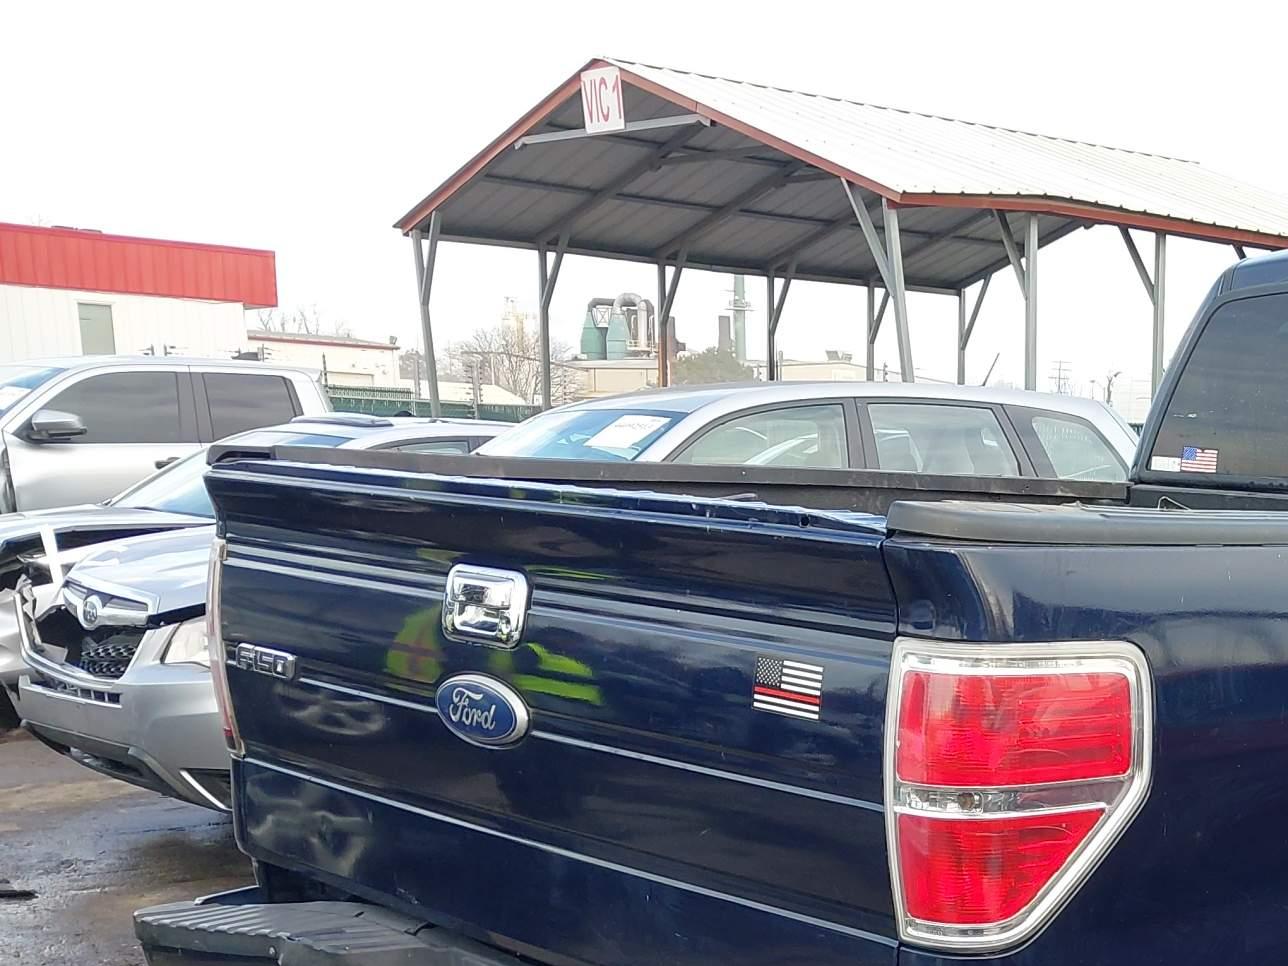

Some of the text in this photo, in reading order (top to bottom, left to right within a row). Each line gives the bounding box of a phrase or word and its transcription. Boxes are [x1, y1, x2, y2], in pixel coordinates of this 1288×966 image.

[582, 74, 622, 124] VIC 1
[449, 687, 496, 730] Ford
